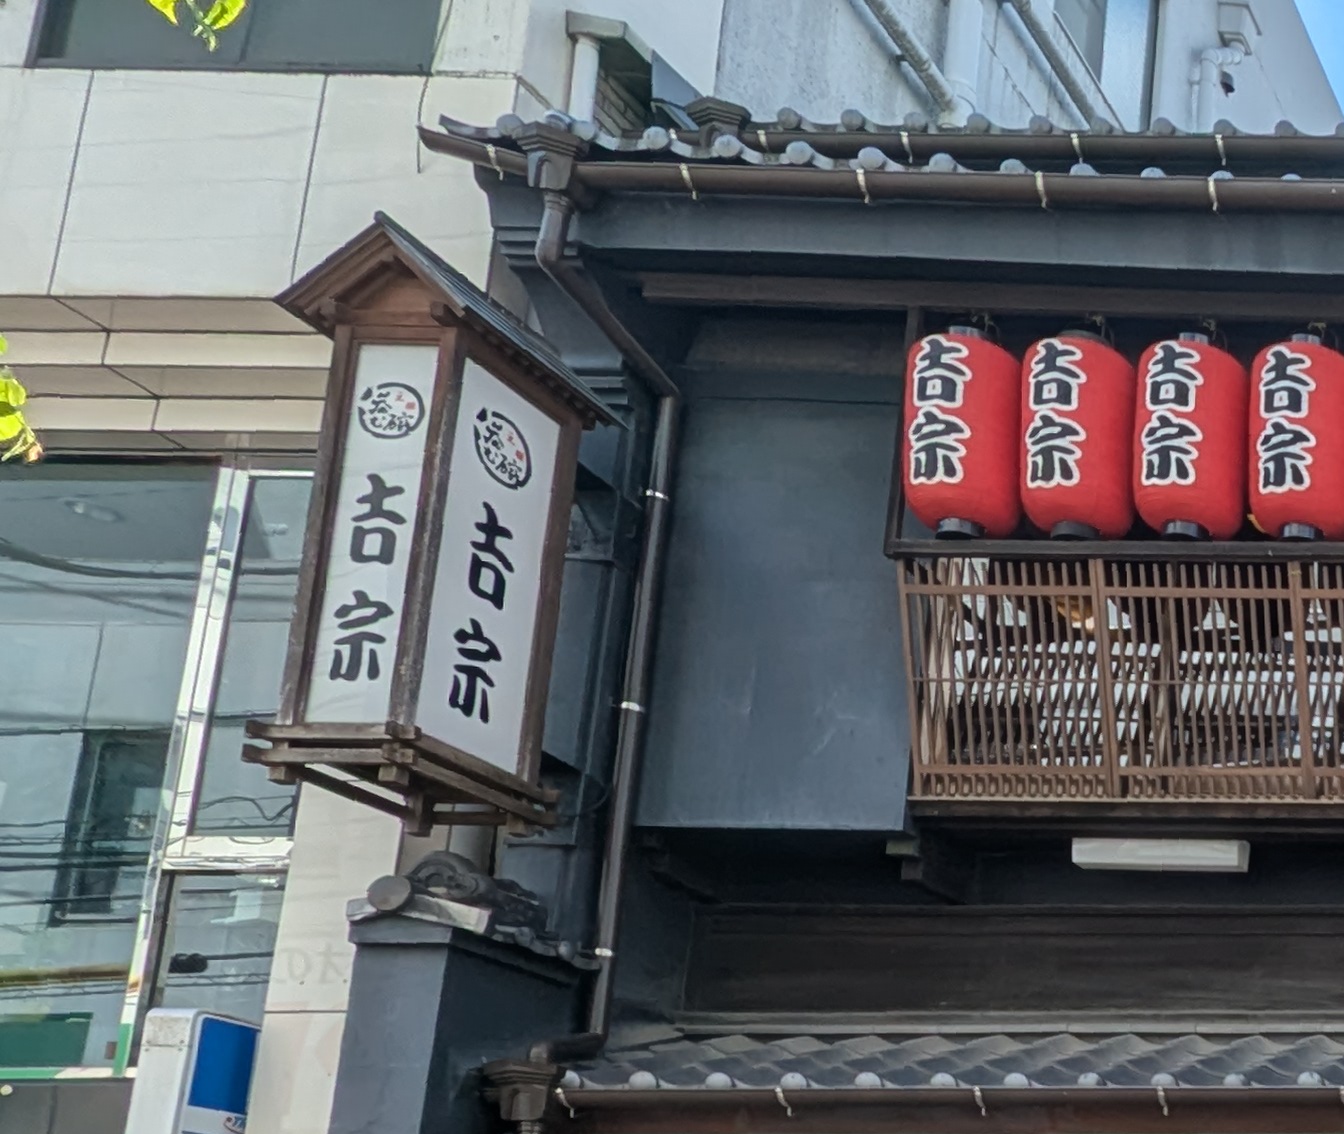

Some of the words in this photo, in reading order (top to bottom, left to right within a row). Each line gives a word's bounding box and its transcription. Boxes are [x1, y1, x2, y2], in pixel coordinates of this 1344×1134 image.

[909, 334, 971, 484] 吉宗
[1025, 338, 1086, 488] 吉宗
[1141, 339, 1203, 486] 吉宗
[1257, 345, 1316, 494] 吉宗
[329, 473, 406, 681] 吉宗
[448, 501, 514, 724] 吉宗
